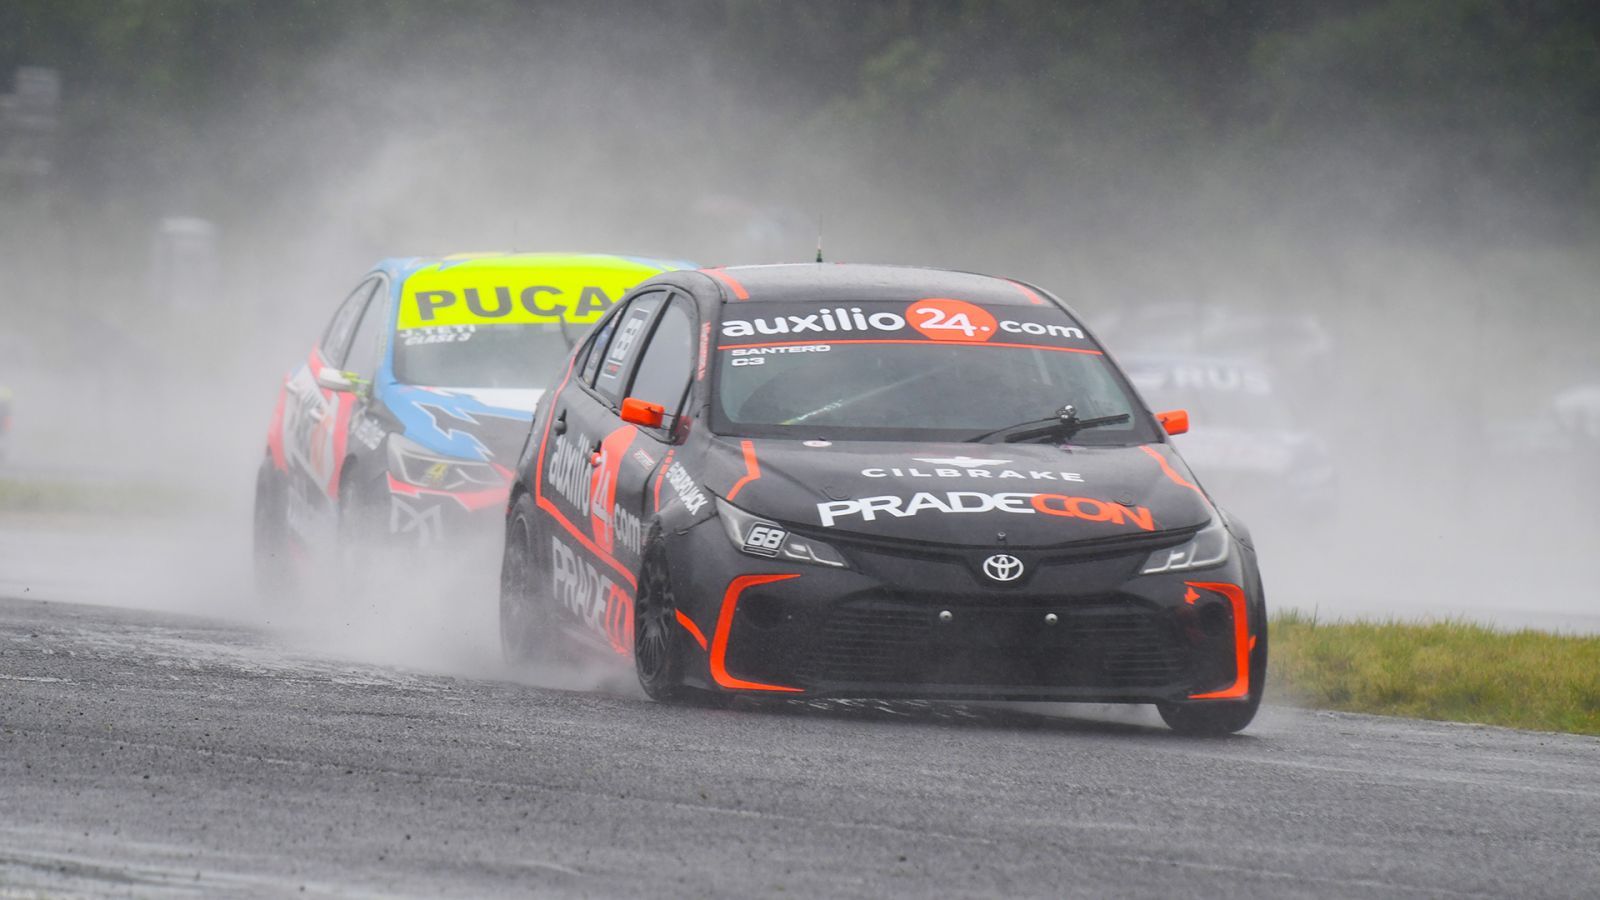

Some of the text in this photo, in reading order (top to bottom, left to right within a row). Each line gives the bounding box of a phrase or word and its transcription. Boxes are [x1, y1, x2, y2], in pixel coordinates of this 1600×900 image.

[415, 286, 633, 320] PUCA
[731, 345, 831, 356] SANTERO
[731, 357, 765, 366] C3
[861, 468, 1085, 482] CILBRAKE
[816, 491, 1155, 531] PRADECON
[747, 526, 785, 549] 68
